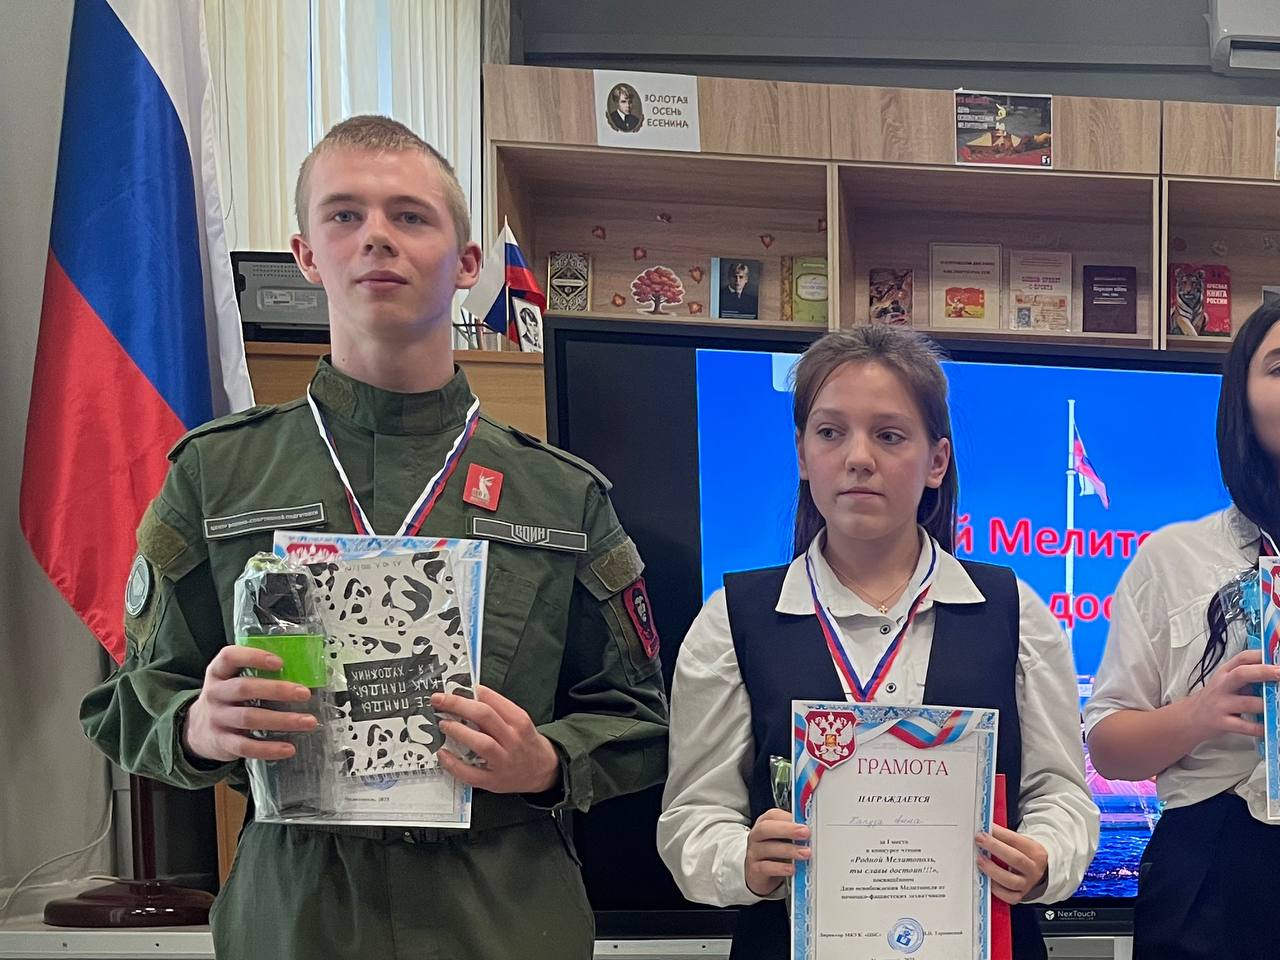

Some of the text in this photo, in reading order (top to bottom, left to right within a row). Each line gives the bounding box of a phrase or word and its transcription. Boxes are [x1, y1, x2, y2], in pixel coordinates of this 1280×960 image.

[644, 94, 688, 104] ЗОЛОТАЯ
[652, 106, 682, 116] ОСЕНЬ
[646, 118, 689, 128] ЕСЕНИНА
[515, 525, 545, 543] ВОИН
[351, 665, 405, 681] ХУДОЖНИК
[361, 697, 409, 713] ПАНДЫ
[858, 757, 948, 776] ГРАМОТА
[858, 795, 930, 803] НАГРАЖДАЕТСЯ
[1057, 910, 1096, 918] NexTouch
